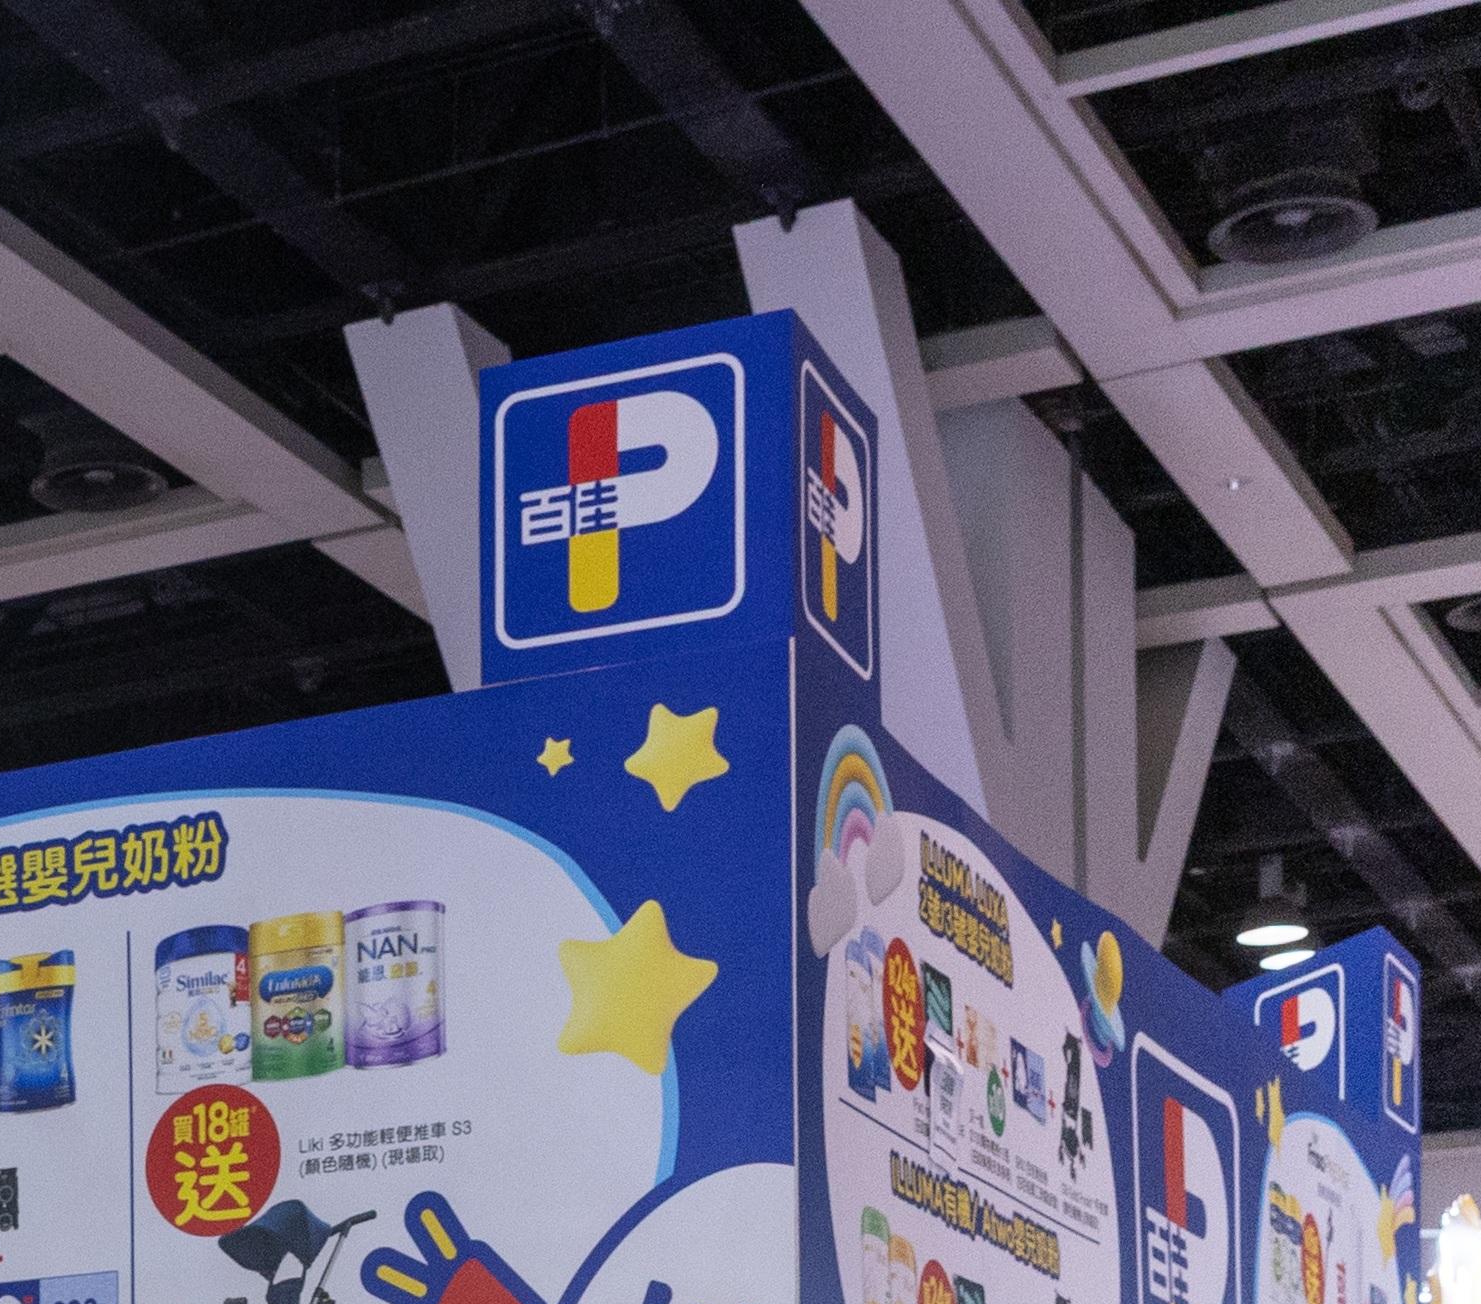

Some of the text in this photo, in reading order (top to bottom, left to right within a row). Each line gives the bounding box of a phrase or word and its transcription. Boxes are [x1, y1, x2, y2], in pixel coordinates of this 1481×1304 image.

[520, 480, 619, 546] 百佳
[357, 933, 419, 962] NAN
[175, 971, 228, 992] Similac
[298, 1120, 472, 1154] Liki 多功能輕便推車 S3
[381, 1145, 445, 1171] (現場取)
[173, 1142, 252, 1227] 送
